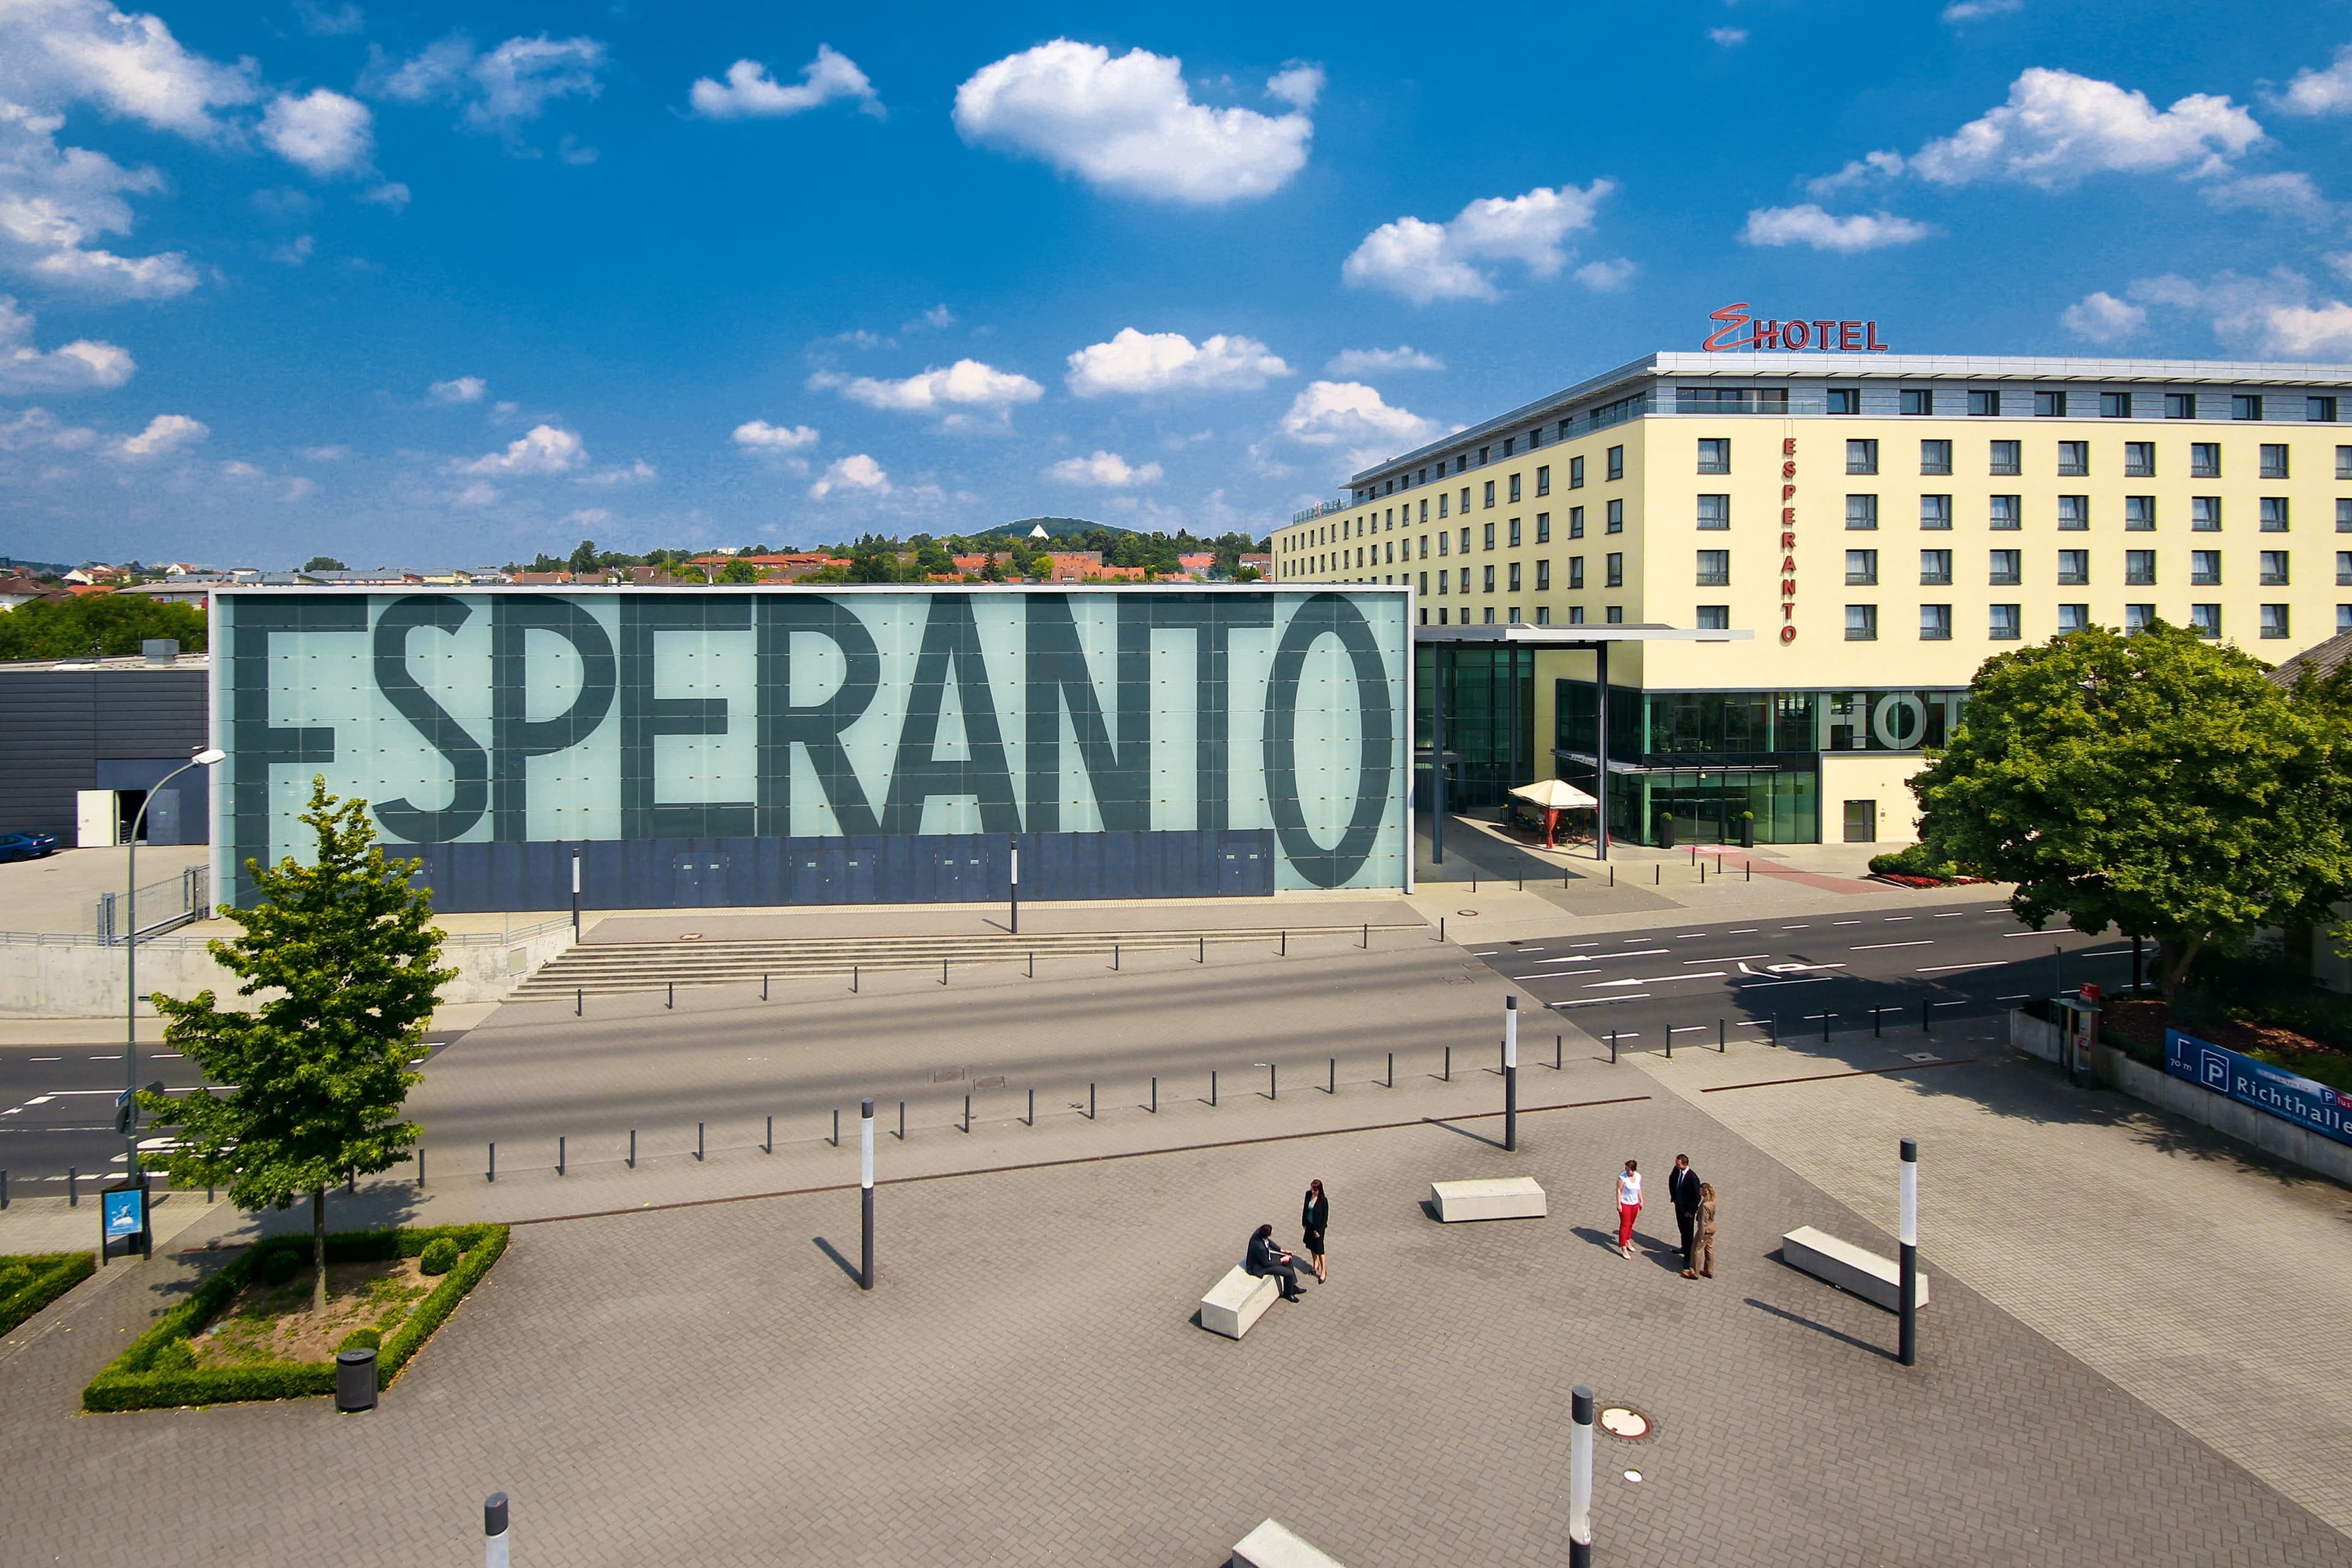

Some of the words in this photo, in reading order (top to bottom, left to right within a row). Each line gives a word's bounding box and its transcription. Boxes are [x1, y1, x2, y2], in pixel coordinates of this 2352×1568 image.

[1753, 319, 1888, 351] HOTEL
[1781, 438, 1797, 642] ESPERANTO
[233, 593, 1393, 910] ESPERANTO
[2170, 1058, 2180, 1066] 70
[2183, 1063, 2192, 1072] m
[2208, 1063, 2224, 1082] P
[2237, 1076, 2352, 1134] Richthalle
